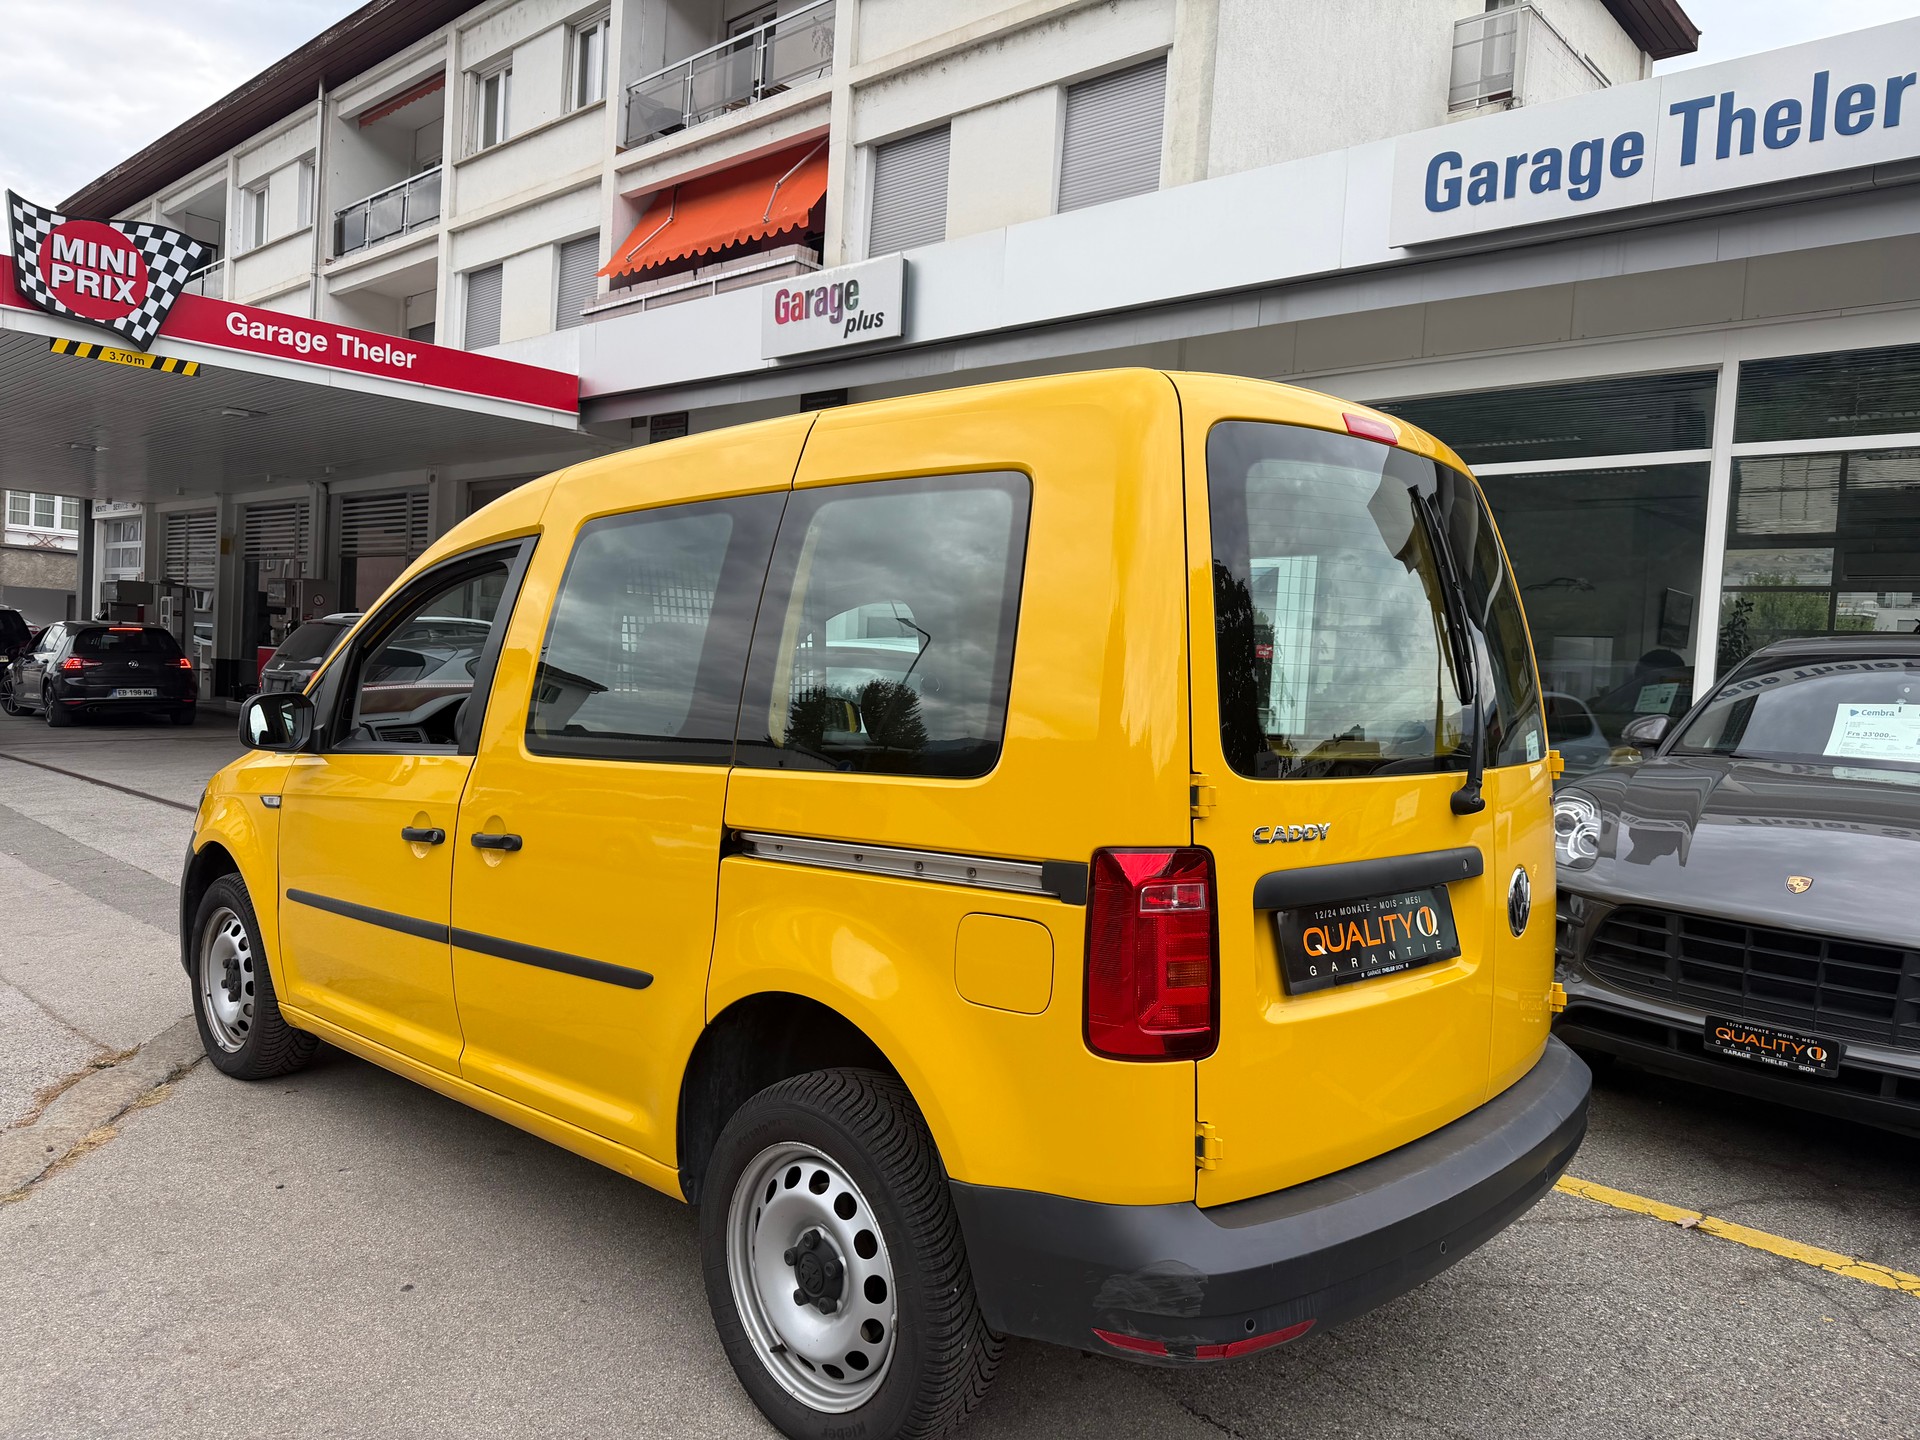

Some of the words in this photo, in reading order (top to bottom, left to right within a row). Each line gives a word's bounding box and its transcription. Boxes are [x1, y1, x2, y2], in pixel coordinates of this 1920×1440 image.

[1424, 130, 1645, 213] Garage
[1669, 69, 1918, 167] Theler
[52, 233, 137, 278] MINI
[51, 263, 137, 306] PRIX
[774, 279, 860, 325] Garage
[843, 310, 885, 339] plus
[226, 311, 328, 354] Garage
[336, 333, 417, 369] Theler
[1253, 822, 1331, 844] CADDY
[1315, 910, 1337, 920] 12/24
[1340, 904, 1371, 916] MONATE
[1379, 899, 1397, 909] MOIS
[1405, 896, 1421, 905] MESI
[1303, 912, 1413, 957] QUALITY
[1310, 940, 1442, 976] GARANTIE
[1715, 1027, 1805, 1055] QUALITY
[1744, 1025, 1769, 1035] MONATE
[1801, 1037, 1818, 1045] MESI
[1715, 1040, 1826, 1068] GARANTIE
[1723, 1048, 1751, 1059] GARAGE
[1761, 1056, 1788, 1067] THELER
[1798, 1065, 1816, 1073] SION
[820, 1421, 867, 1440] Kleber
